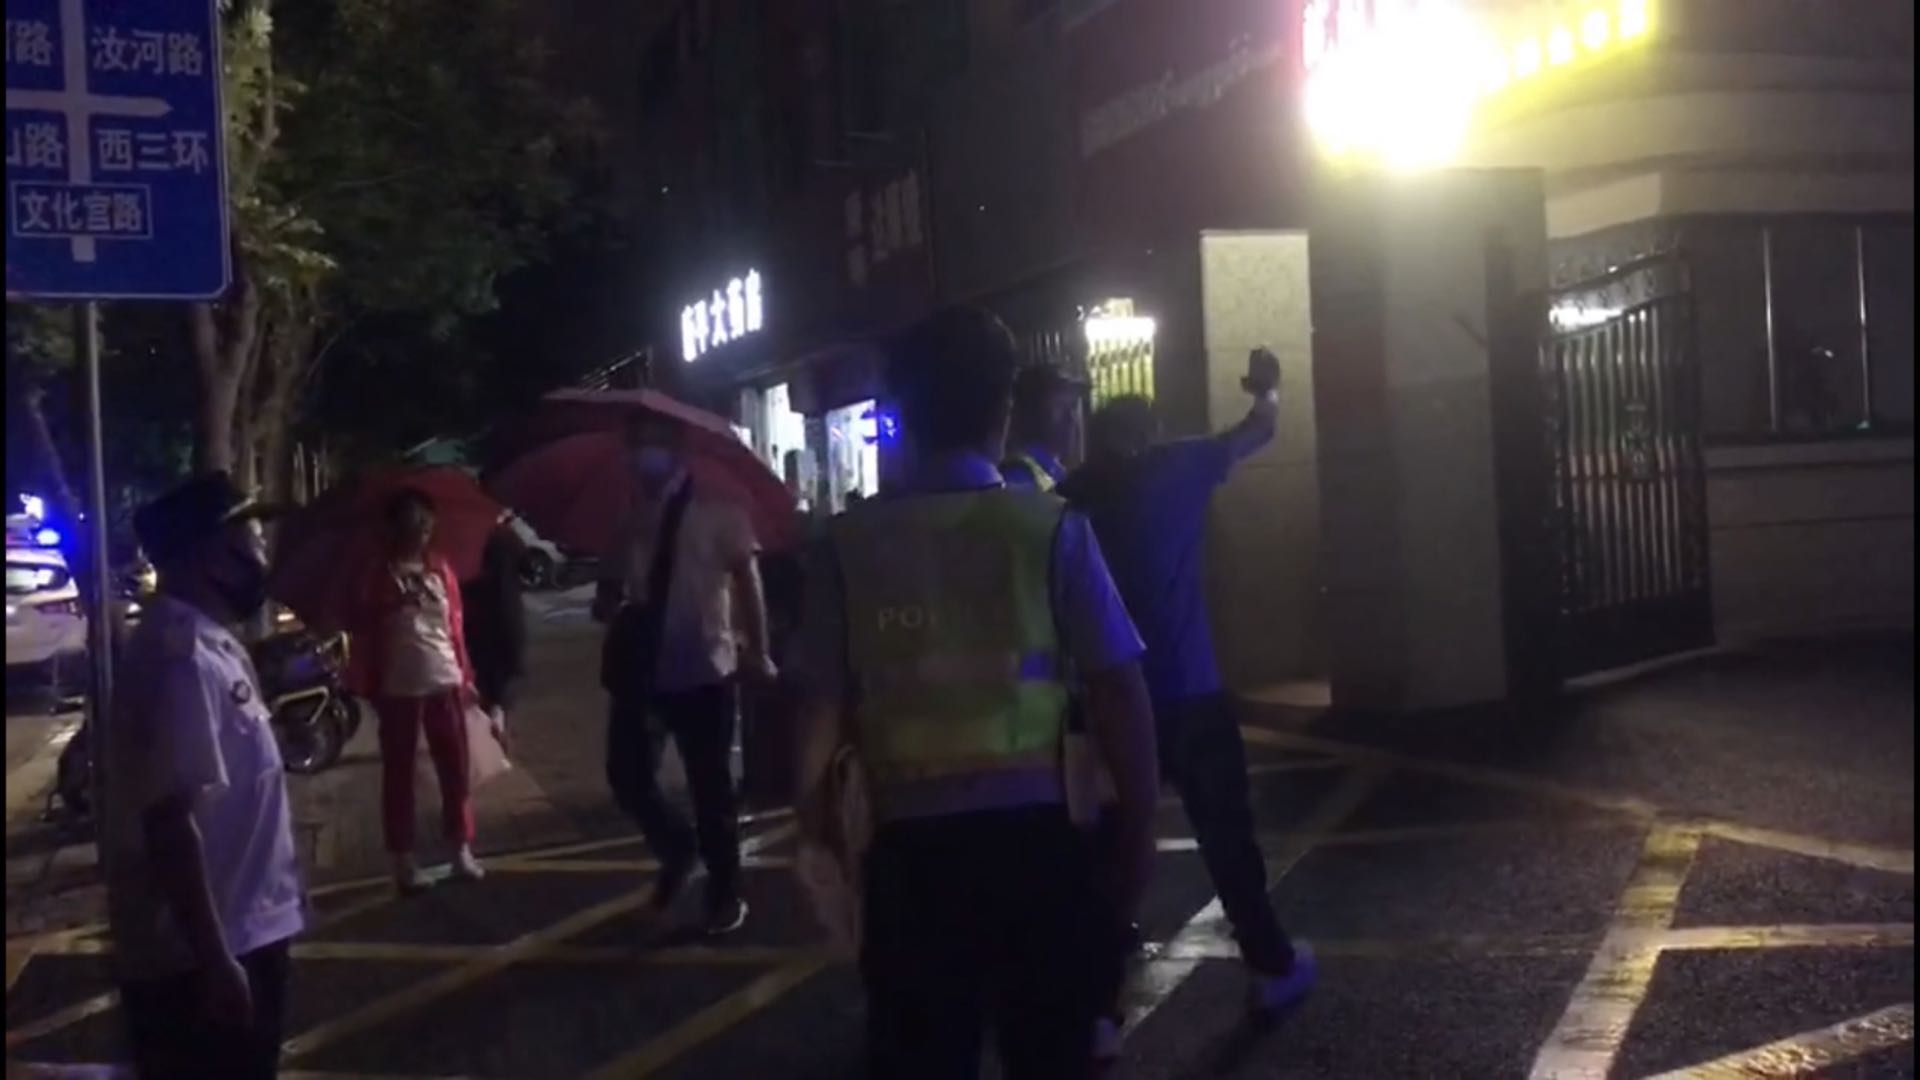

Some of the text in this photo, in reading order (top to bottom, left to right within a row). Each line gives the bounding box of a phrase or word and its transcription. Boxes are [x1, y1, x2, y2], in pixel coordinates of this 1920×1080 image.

[6, 20, 53, 66] 路
[91, 26, 203, 76] 汝河路
[95, 128, 209, 174] 西三环
